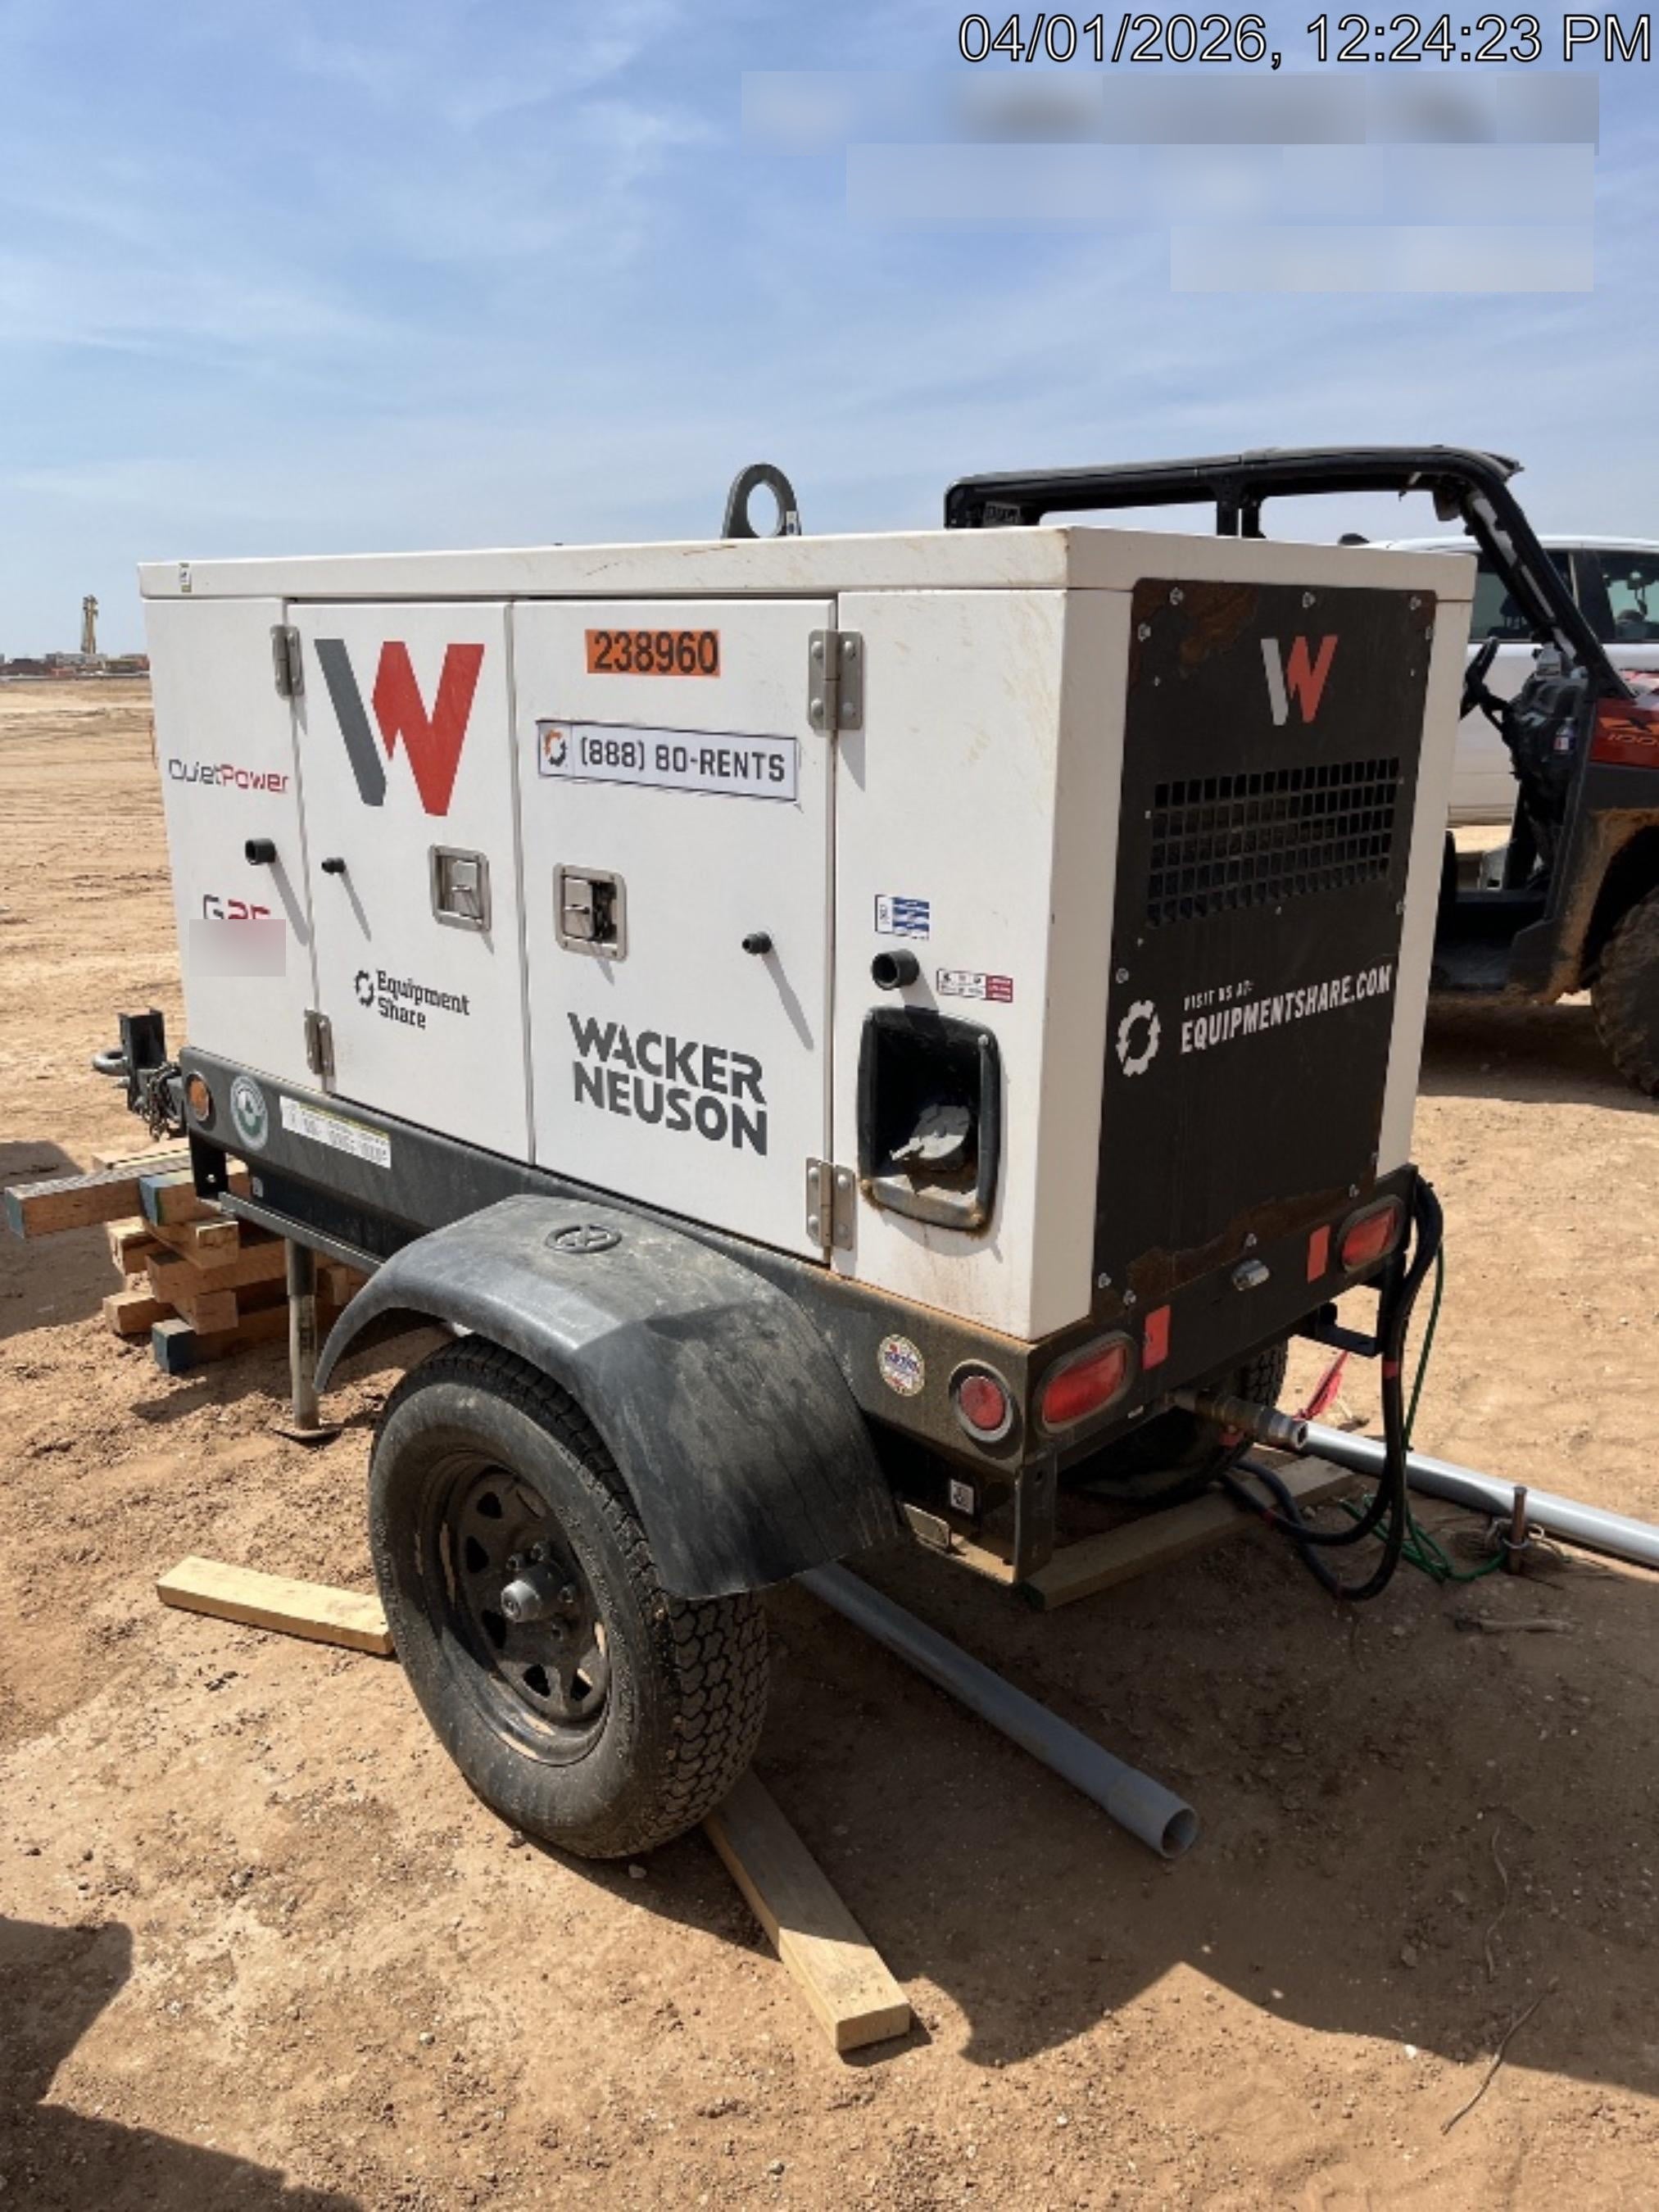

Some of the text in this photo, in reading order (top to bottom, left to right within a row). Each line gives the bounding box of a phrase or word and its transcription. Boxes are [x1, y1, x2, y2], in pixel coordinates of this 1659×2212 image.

[593, 630, 718, 674] 238960
[580, 737, 786, 782] (888) 80-RENTS
[376, 968, 470, 1017] Equipment
[378, 995, 427, 1031] Share
[1180, 963, 1393, 1055] EQUIPMENTSHARE.COM
[566, 1011, 768, 1105] WACKER
[573, 1060, 768, 1157] NEUSON
